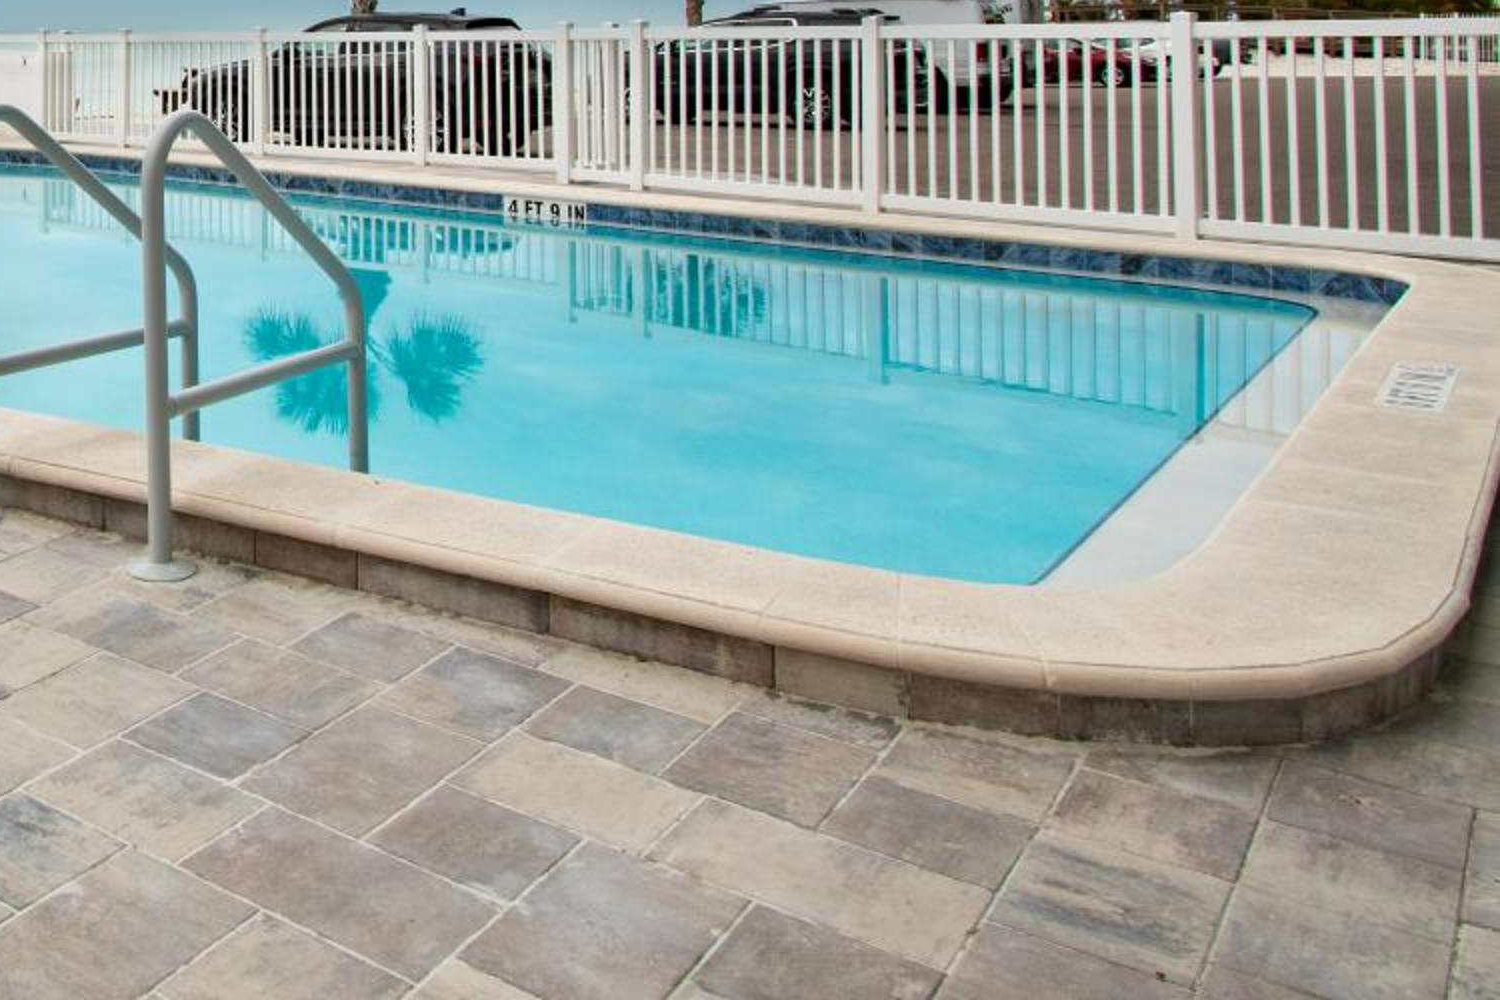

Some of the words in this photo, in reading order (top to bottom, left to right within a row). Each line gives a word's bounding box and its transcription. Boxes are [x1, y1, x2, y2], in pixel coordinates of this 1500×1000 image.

[508, 199, 518, 215] 4
[525, 200, 543, 216] FT
[550, 203, 560, 217] 9
[567, 204, 584, 219] IN
